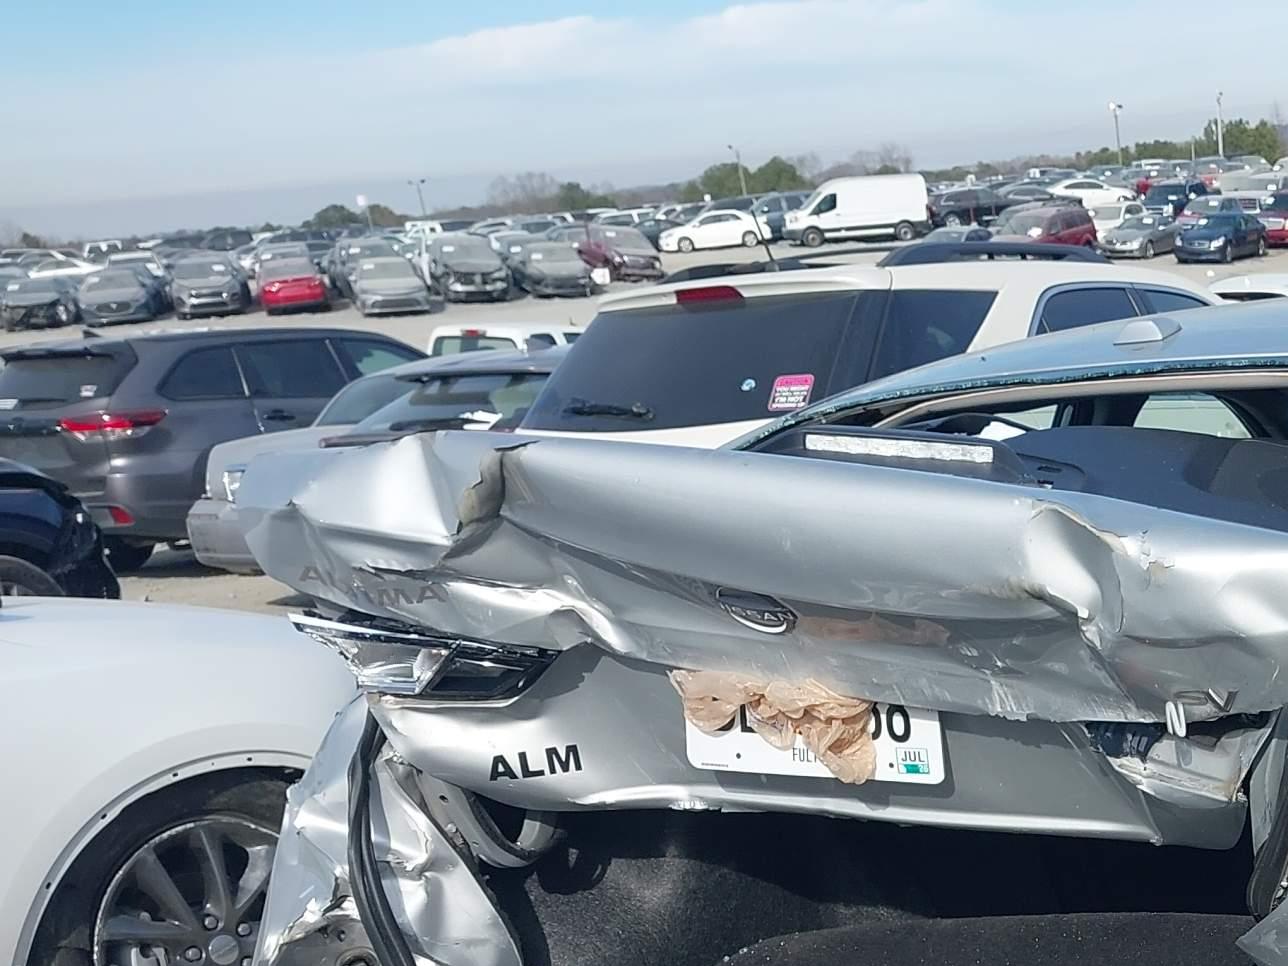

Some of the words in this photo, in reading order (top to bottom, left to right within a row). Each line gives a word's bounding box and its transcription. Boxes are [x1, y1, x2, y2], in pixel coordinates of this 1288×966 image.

[299, 565, 449, 607] ALMA
[489, 744, 583, 782] ALM
[793, 747, 817, 763] FUL
[901, 751, 925, 763] JUL
